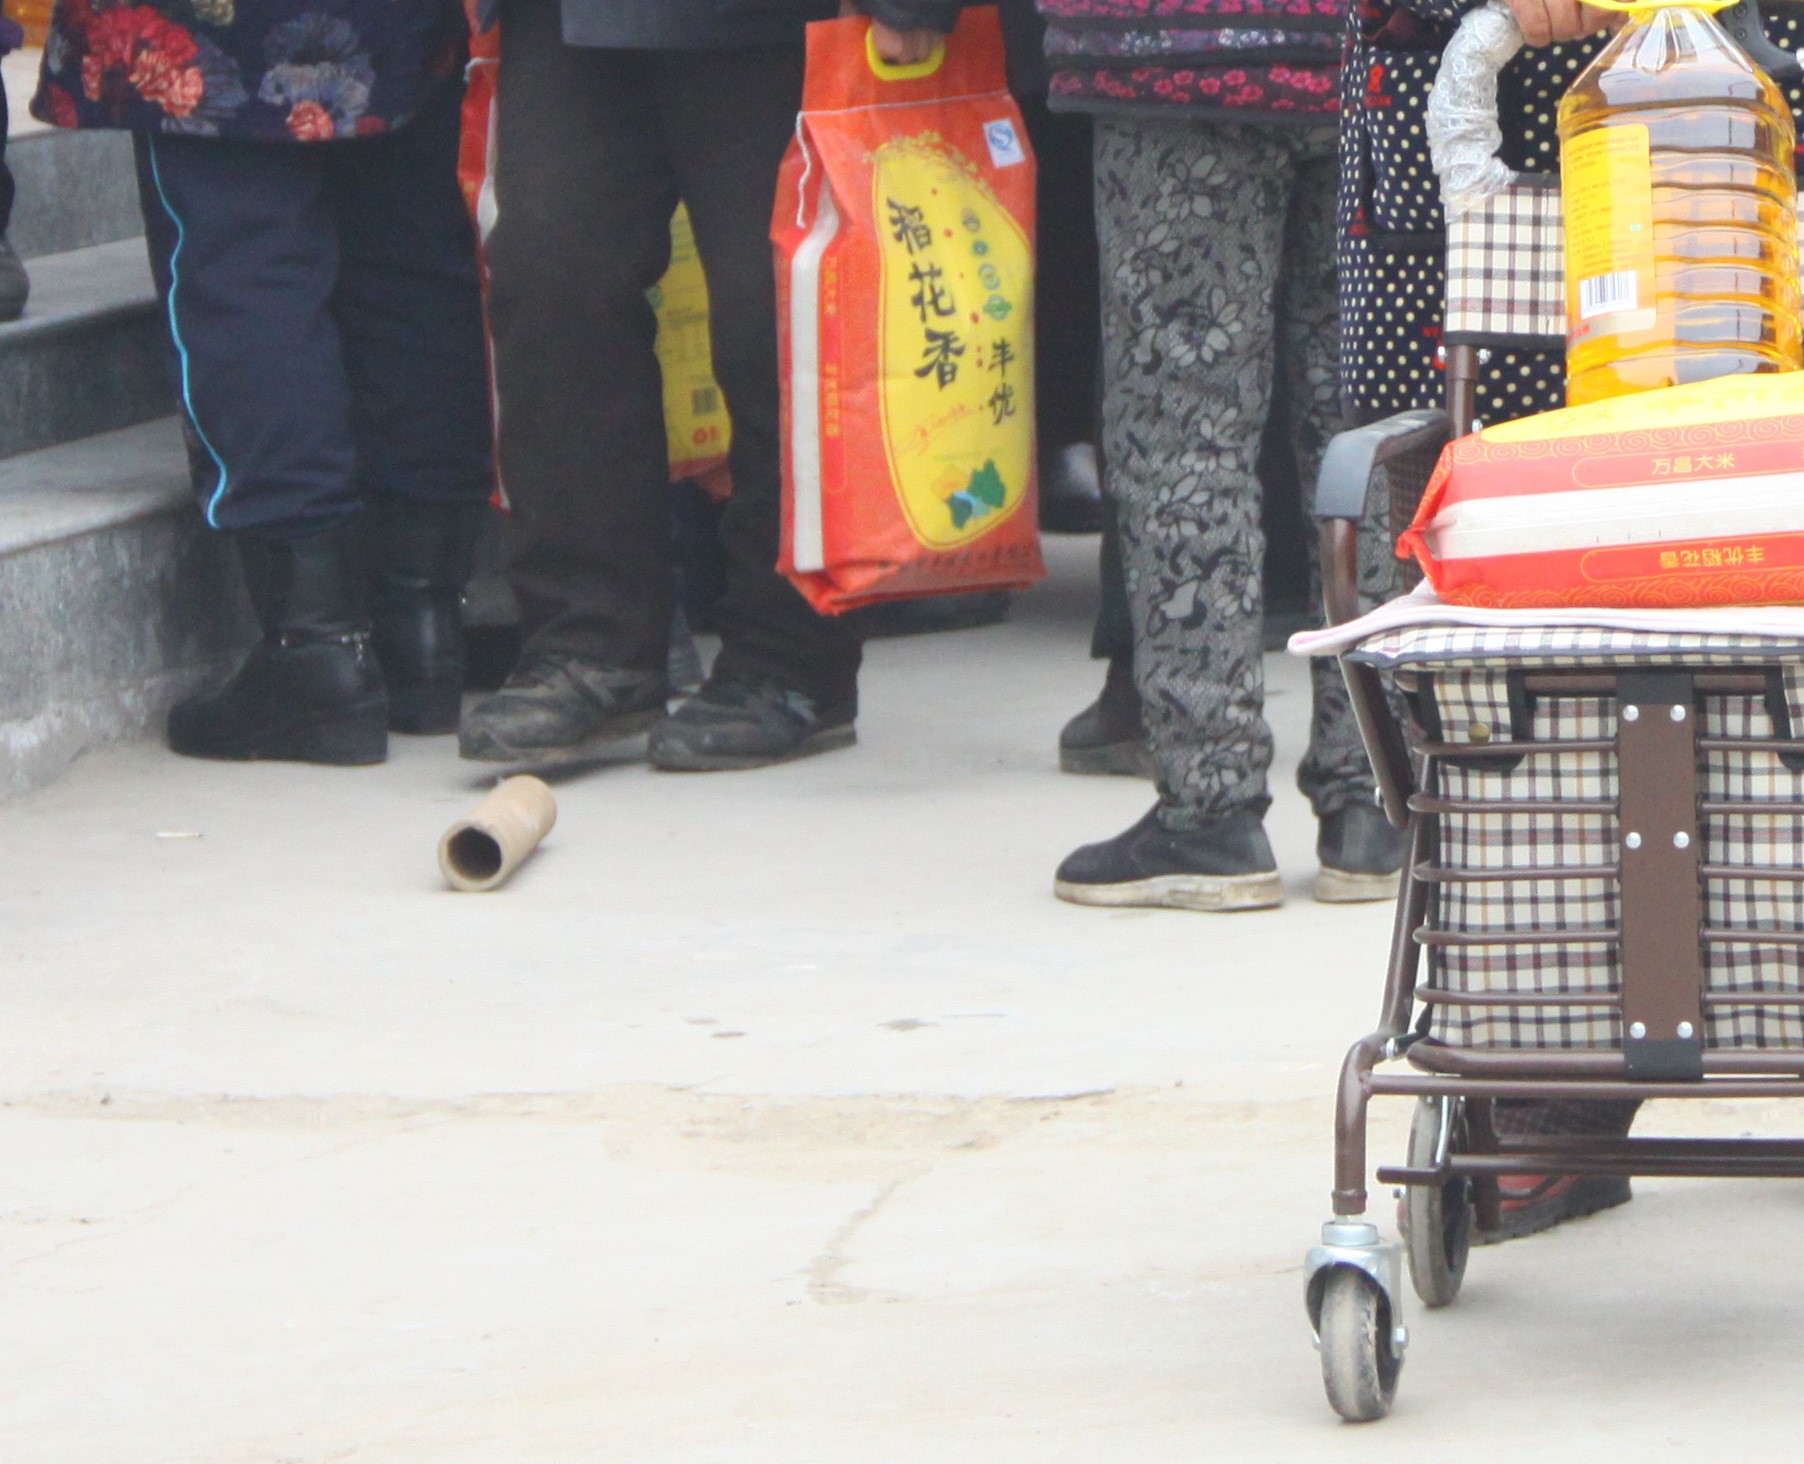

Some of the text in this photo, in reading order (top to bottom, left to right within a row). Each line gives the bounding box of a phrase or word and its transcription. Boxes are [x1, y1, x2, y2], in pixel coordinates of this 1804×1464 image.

[886, 197, 966, 391] 稻花香
[987, 337, 1017, 427] 丰优
[1651, 453, 1736, 475] 万昌大米
[1660, 544, 1765, 569] 丰优稻花香
